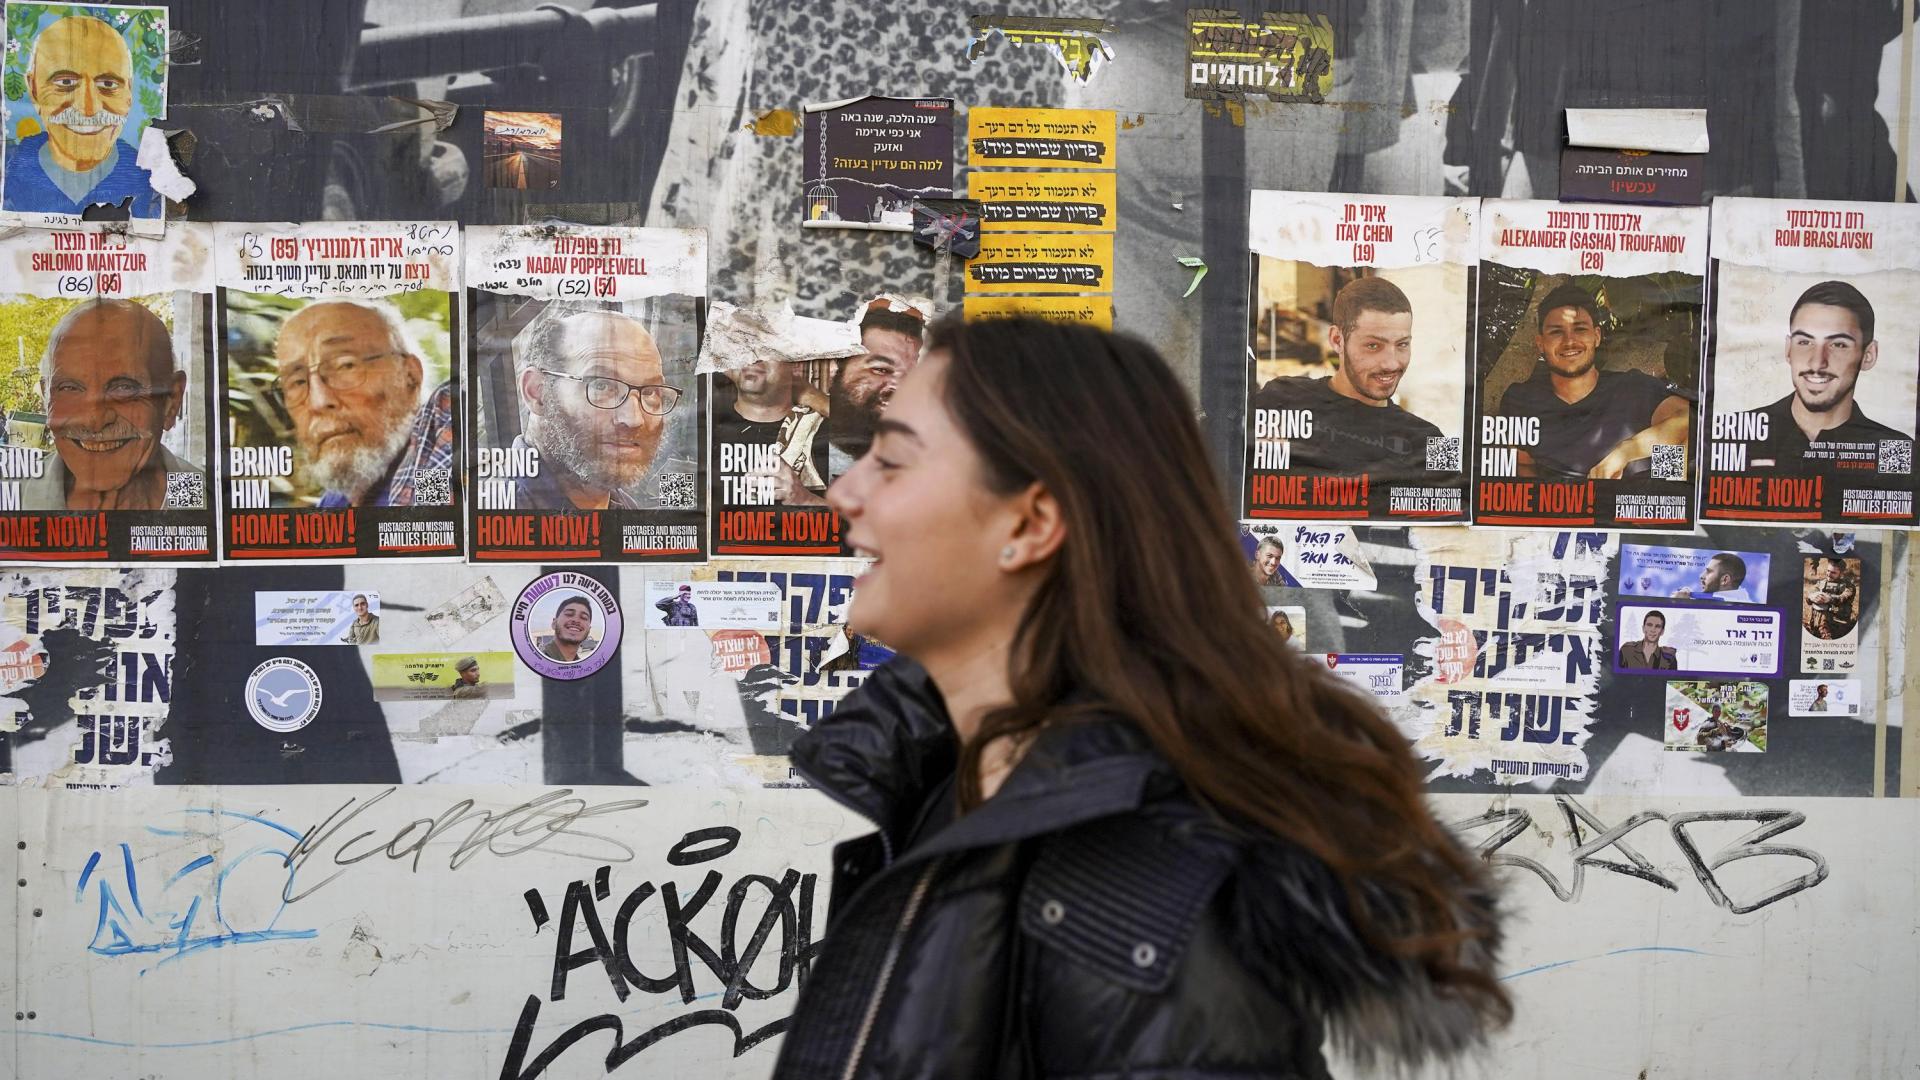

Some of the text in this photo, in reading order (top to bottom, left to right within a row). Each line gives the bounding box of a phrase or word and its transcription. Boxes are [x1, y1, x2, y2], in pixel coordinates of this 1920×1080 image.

[841, 113, 936, 125] שנה הלכה, שנה באה
[978, 119, 1096, 135] לא תעמוד על דם רעך-
[855, 128, 921, 137] אני כפי ארימה
[874, 142, 903, 153] ואזעק
[983, 141, 1098, 159] פדיון שבויים מיד!
[833, 157, 943, 171] למה הם עדיין בעזה?
[1575, 164, 1688, 177] מחזירים אותם הביתה.
[978, 182, 1096, 198] לא תעמוד על דם רעך-
[1611, 180, 1656, 193] עכשיו!
[983, 203, 1098, 221] פדיון שבויים מיד!
[1344, 204, 1386, 223] איתי חן
[1547, 211, 1642, 232] אלכסנדר טרופנוב
[1787, 210, 1864, 229] רום ברסלבסקי
[51, 233, 86, 251] מנצור
[1336, 224, 1393, 242] ITAY CHEN
[1501, 229, 1686, 254] ALEXANDER (SASHA) TROUFANOV
[1775, 229, 1873, 249] ROM BRASLAVSKI
[271, 237, 298, 261] (85)
[370, 237, 403, 258] אריה
[601, 238, 621, 255] נדב
[1005, 244, 1094, 258] לא תעמוד על דם
[1353, 243, 1374, 263] (19)
[32, 253, 146, 272] SHLOMO MANTZUR
[527, 256, 647, 275] NADAV POPPLEWELL
[1581, 252, 1604, 272] (28)
[243, 262, 430, 282] נרצח על ידי חמאס. עדיין חטוף בעזה.
[980, 266, 1095, 283] פדיון שבויים מיד!
[58, 275, 93, 295] (86)
[557, 279, 591, 297] (52)
[1079, 306, 1094, 320] לא
[1254, 408, 1313, 439] BRING
[1481, 415, 1540, 446] BRING
[1711, 412, 1769, 441] BRING
[0, 449, 44, 478] RING
[230, 446, 293, 476] BRING
[477, 447, 539, 477] BRING
[720, 443, 780, 473] BRING
[1253, 440, 1291, 470] HIM
[1480, 447, 1517, 477] HIM
[1710, 442, 1746, 472] HIM
[231, 479, 270, 508] HIM
[477, 480, 516, 509] HIM
[720, 476, 775, 505] THEM
[1252, 473, 1369, 506] HOME NOW!
[1390, 487, 1462, 498] HOSTAGES AND MISSING
[1479, 480, 1594, 514] HOME NOW!
[1709, 475, 1822, 509] HOME NOW!
[1843, 489, 1912, 500] HOSTAGES AND MISSING
[1390, 497, 1461, 512] FAMILIES FORUM
[1616, 495, 1686, 505] HOSTAGES AND MISSING
[1842, 500, 1912, 514] FAMILIES FORUM
[1616, 505, 1685, 520] FAMILIES FORUM
[0, 512, 108, 547] OME NOW!
[130, 526, 207, 536] HOSTAGES AND MISSING
[231, 508, 355, 544] HOME NOW!
[378, 521, 454, 532] HOSTAGES AND MISSING
[477, 511, 600, 545] HOME NOW!
[623, 525, 697, 535] HOSTAGES AND MISSING
[720, 510, 840, 542] HOME NOW!
[130, 536, 207, 551] FAMILIES FORUM
[379, 532, 454, 547] FAMILIES FORUM
[623, 536, 698, 549] FAMILIES FORUM
[563, 573, 577, 584] לנו
[578, 576, 600, 594] ציווה
[524, 575, 559, 603] לעשות
[515, 601, 529, 621] חיים
[1726, 629, 1773, 640] דרך ארז
